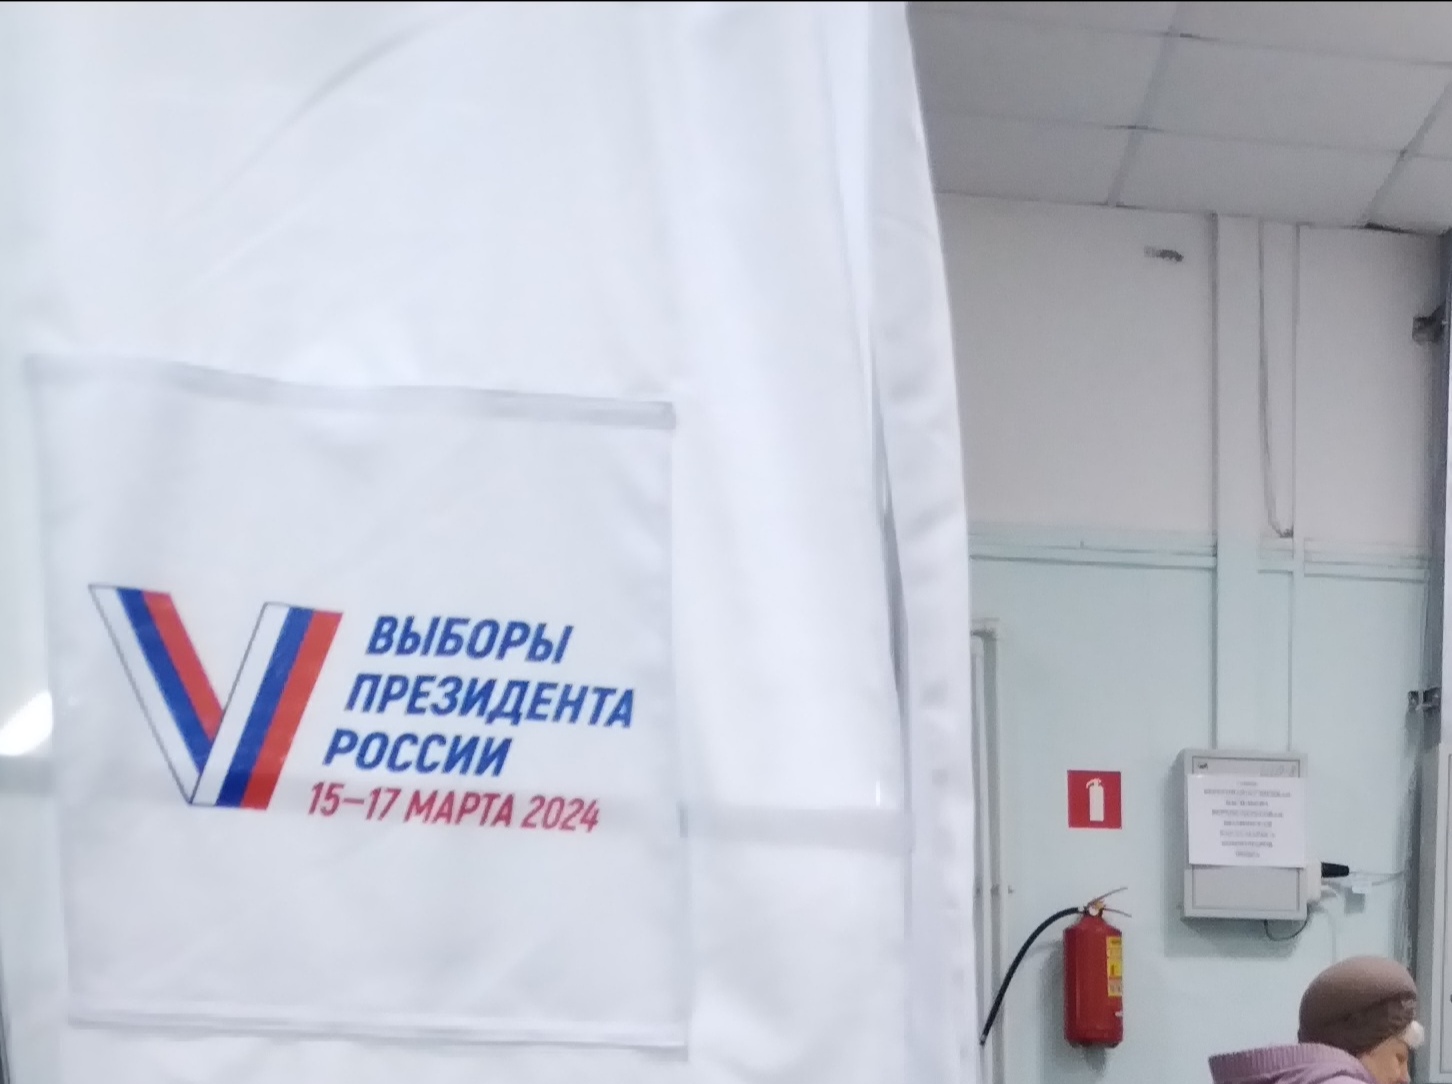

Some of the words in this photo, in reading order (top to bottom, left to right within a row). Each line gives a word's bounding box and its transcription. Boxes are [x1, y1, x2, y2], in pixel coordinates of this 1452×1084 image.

[366, 615, 574, 665] ВЫБОРЫ
[345, 672, 635, 729] ПРЕЗИДЕНТА
[322, 727, 513, 776] РОССИИ
[404, 788, 514, 829] МАРТА
[521, 796, 600, 834] 2024
